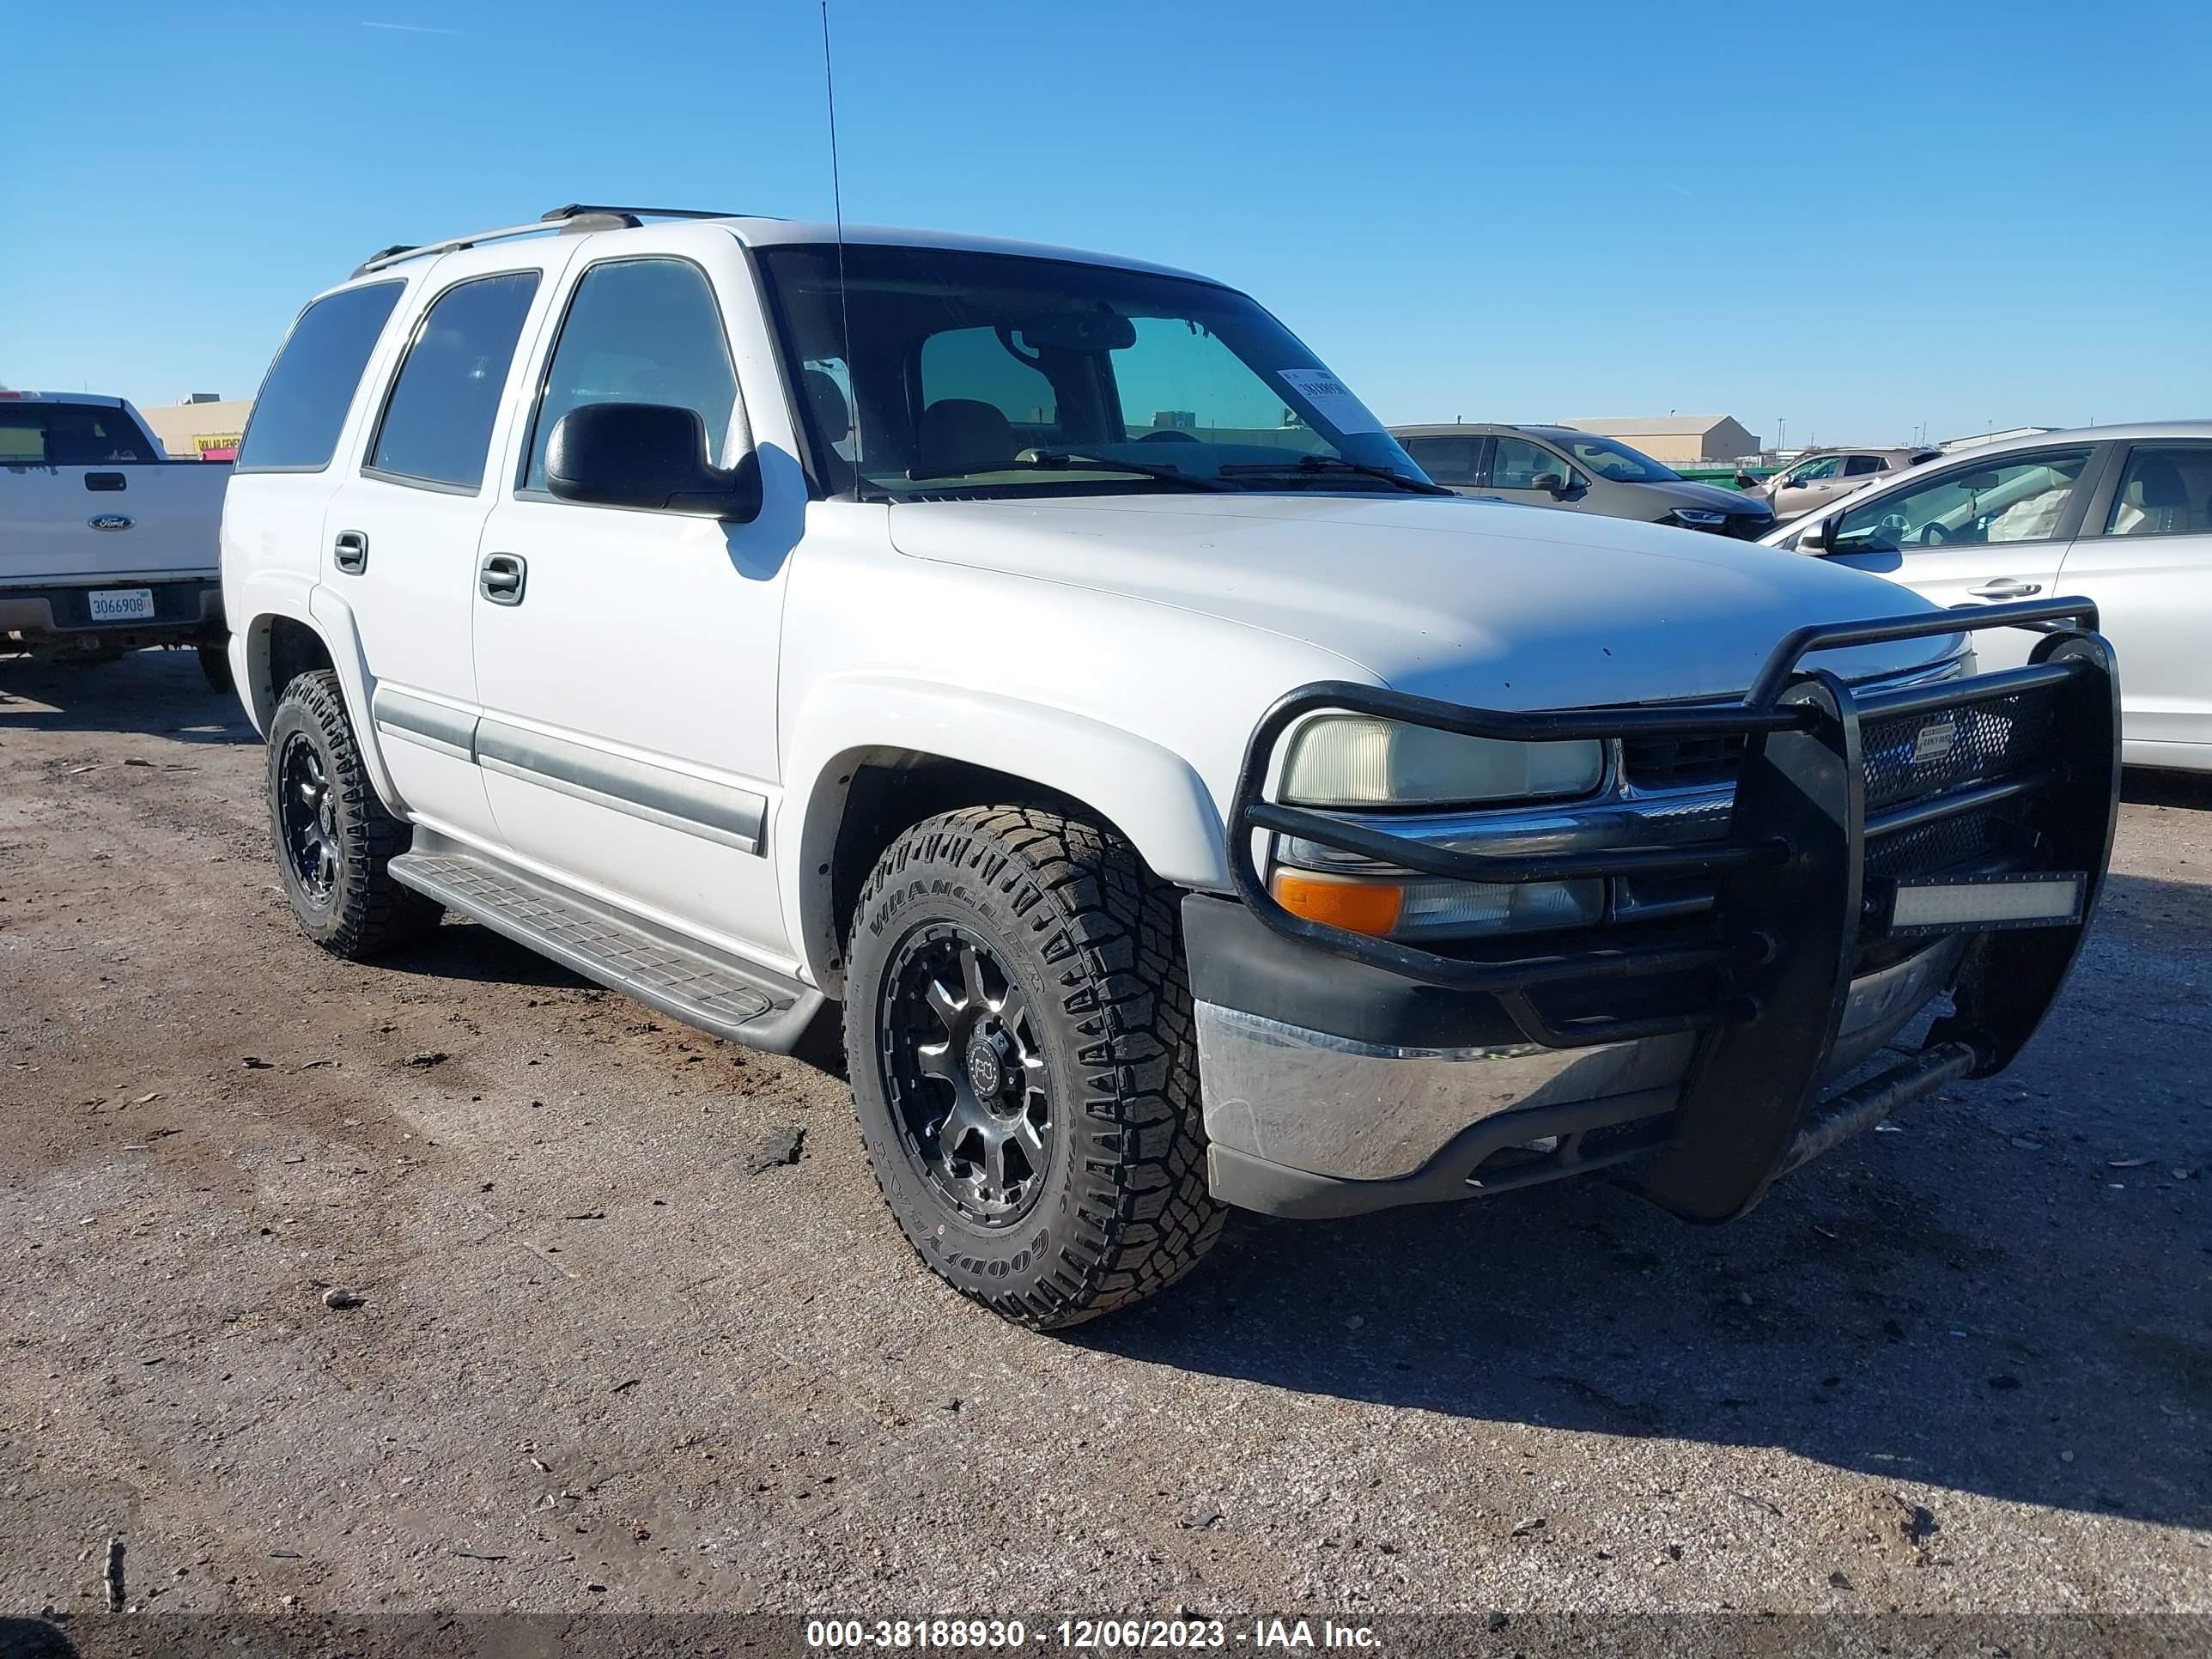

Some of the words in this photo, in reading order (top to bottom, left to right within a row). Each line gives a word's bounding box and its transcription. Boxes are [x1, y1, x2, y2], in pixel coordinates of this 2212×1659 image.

[198, 439, 221, 451] DOLLAR
[99, 518, 125, 528] Ford
[869, 878, 1046, 994] WRANGLER
[872, 1140, 1049, 1279] GOODYEAR
